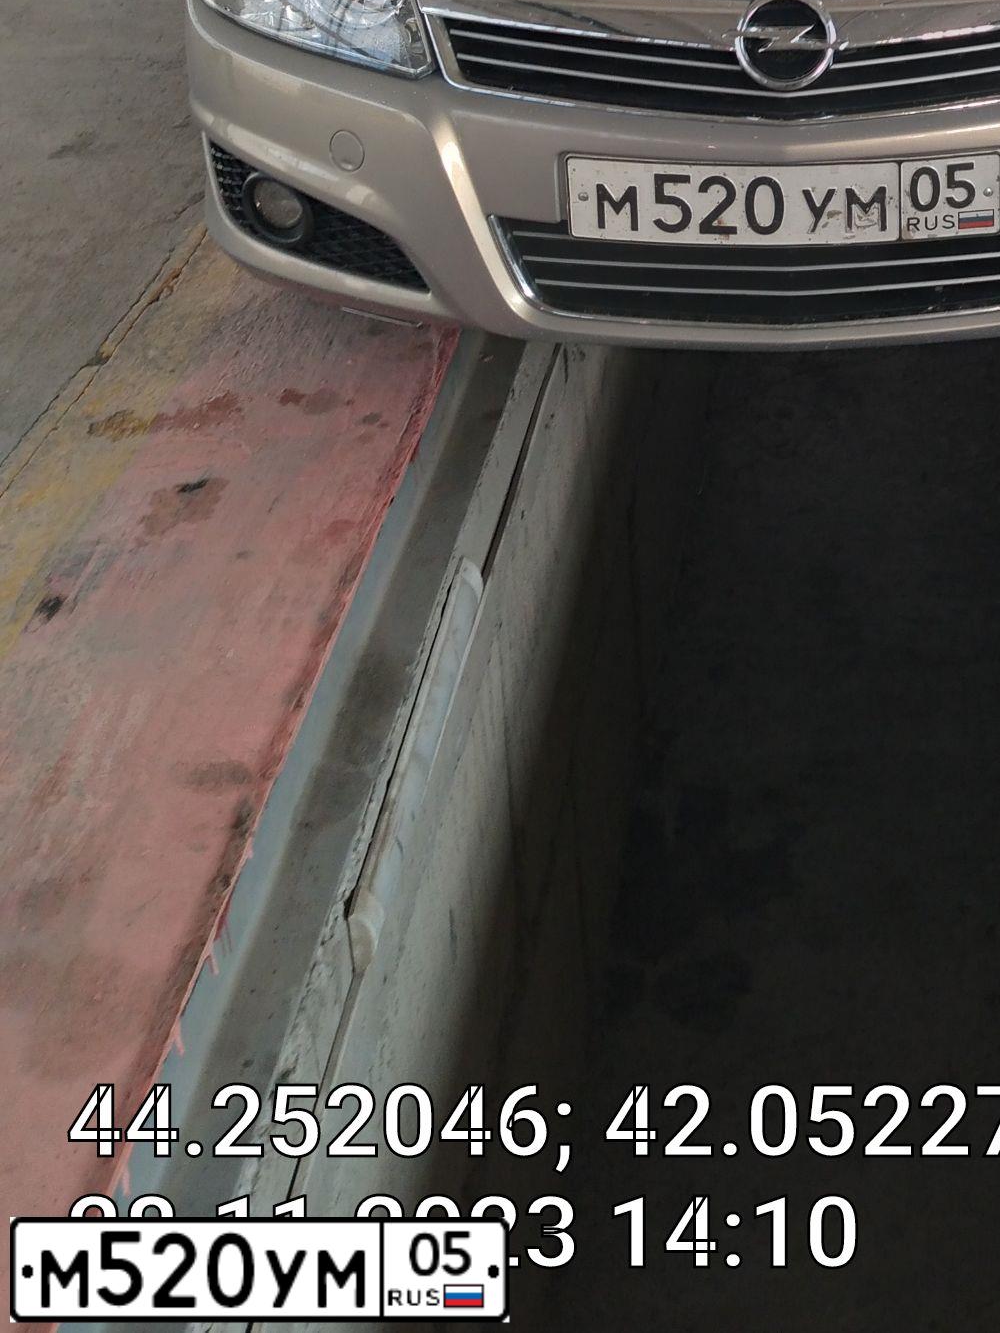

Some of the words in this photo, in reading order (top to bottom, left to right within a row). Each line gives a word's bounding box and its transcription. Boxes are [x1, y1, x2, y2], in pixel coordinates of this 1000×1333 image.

[597, 173, 887, 235] М520УМ
[909, 162, 977, 212] 05
[906, 214, 956, 232] RUS
